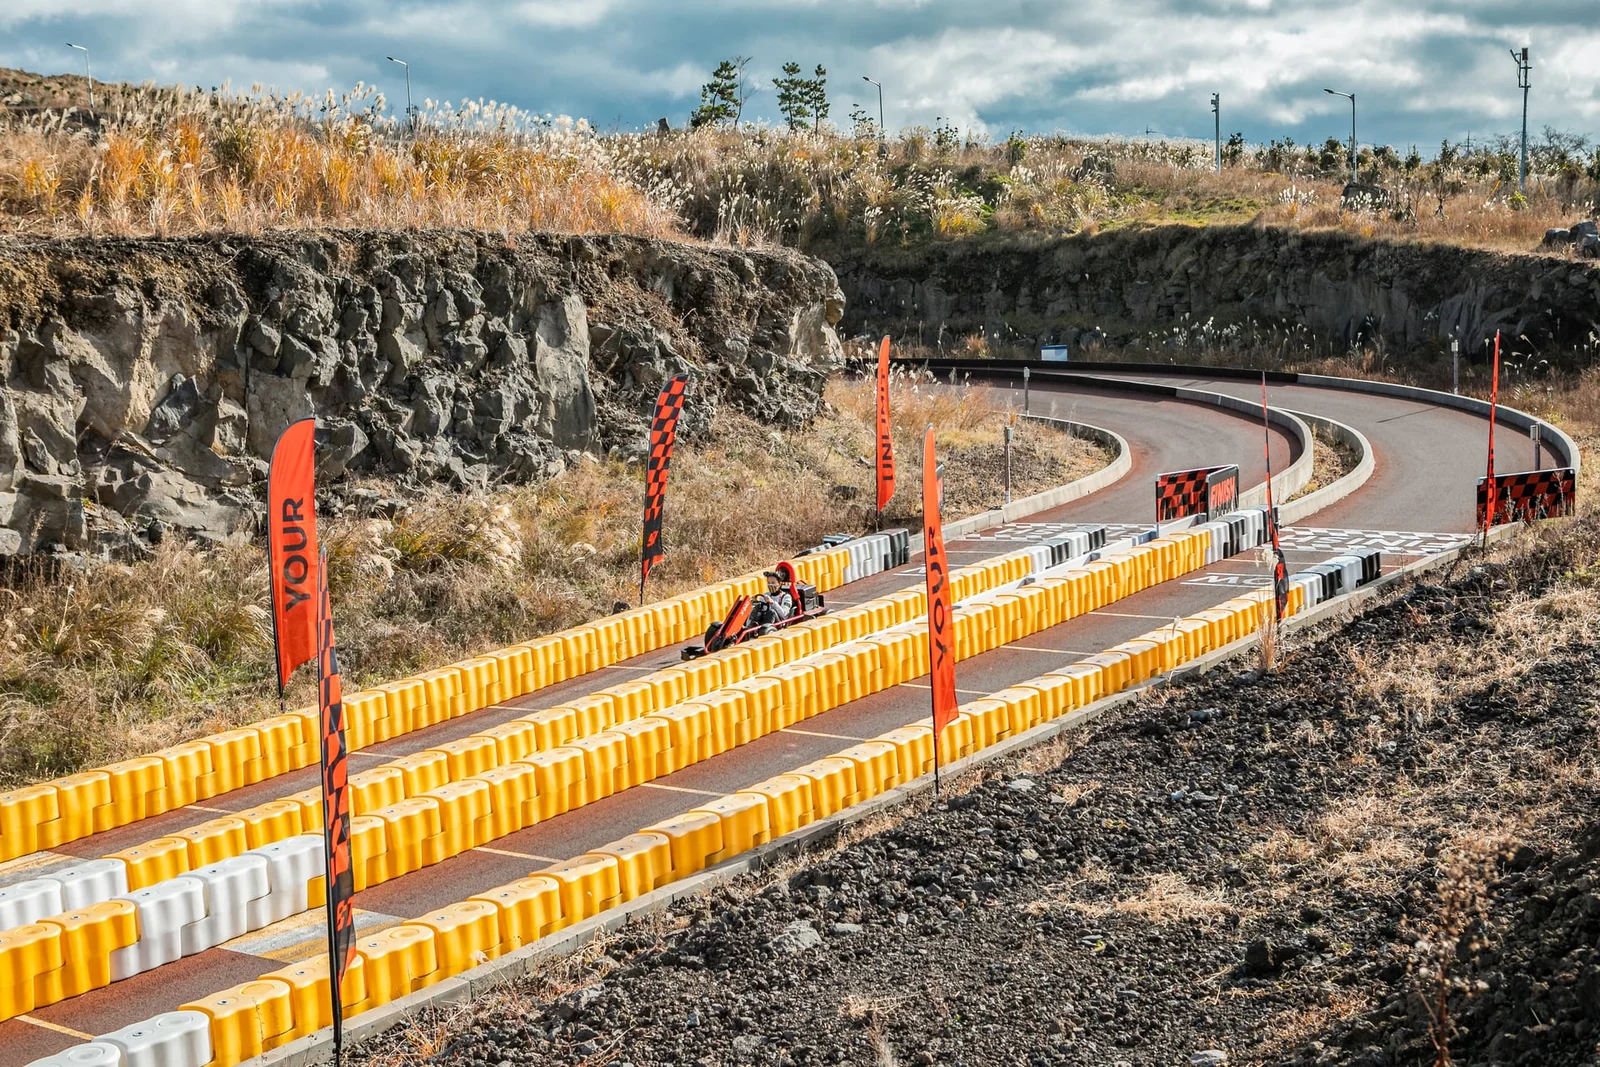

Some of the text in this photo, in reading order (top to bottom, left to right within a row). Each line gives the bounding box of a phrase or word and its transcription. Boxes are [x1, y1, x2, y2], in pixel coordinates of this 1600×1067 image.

[282, 497, 311, 612] YOUR
[930, 525, 946, 669] YOUR
[1278, 534, 1460, 549] FINISH
